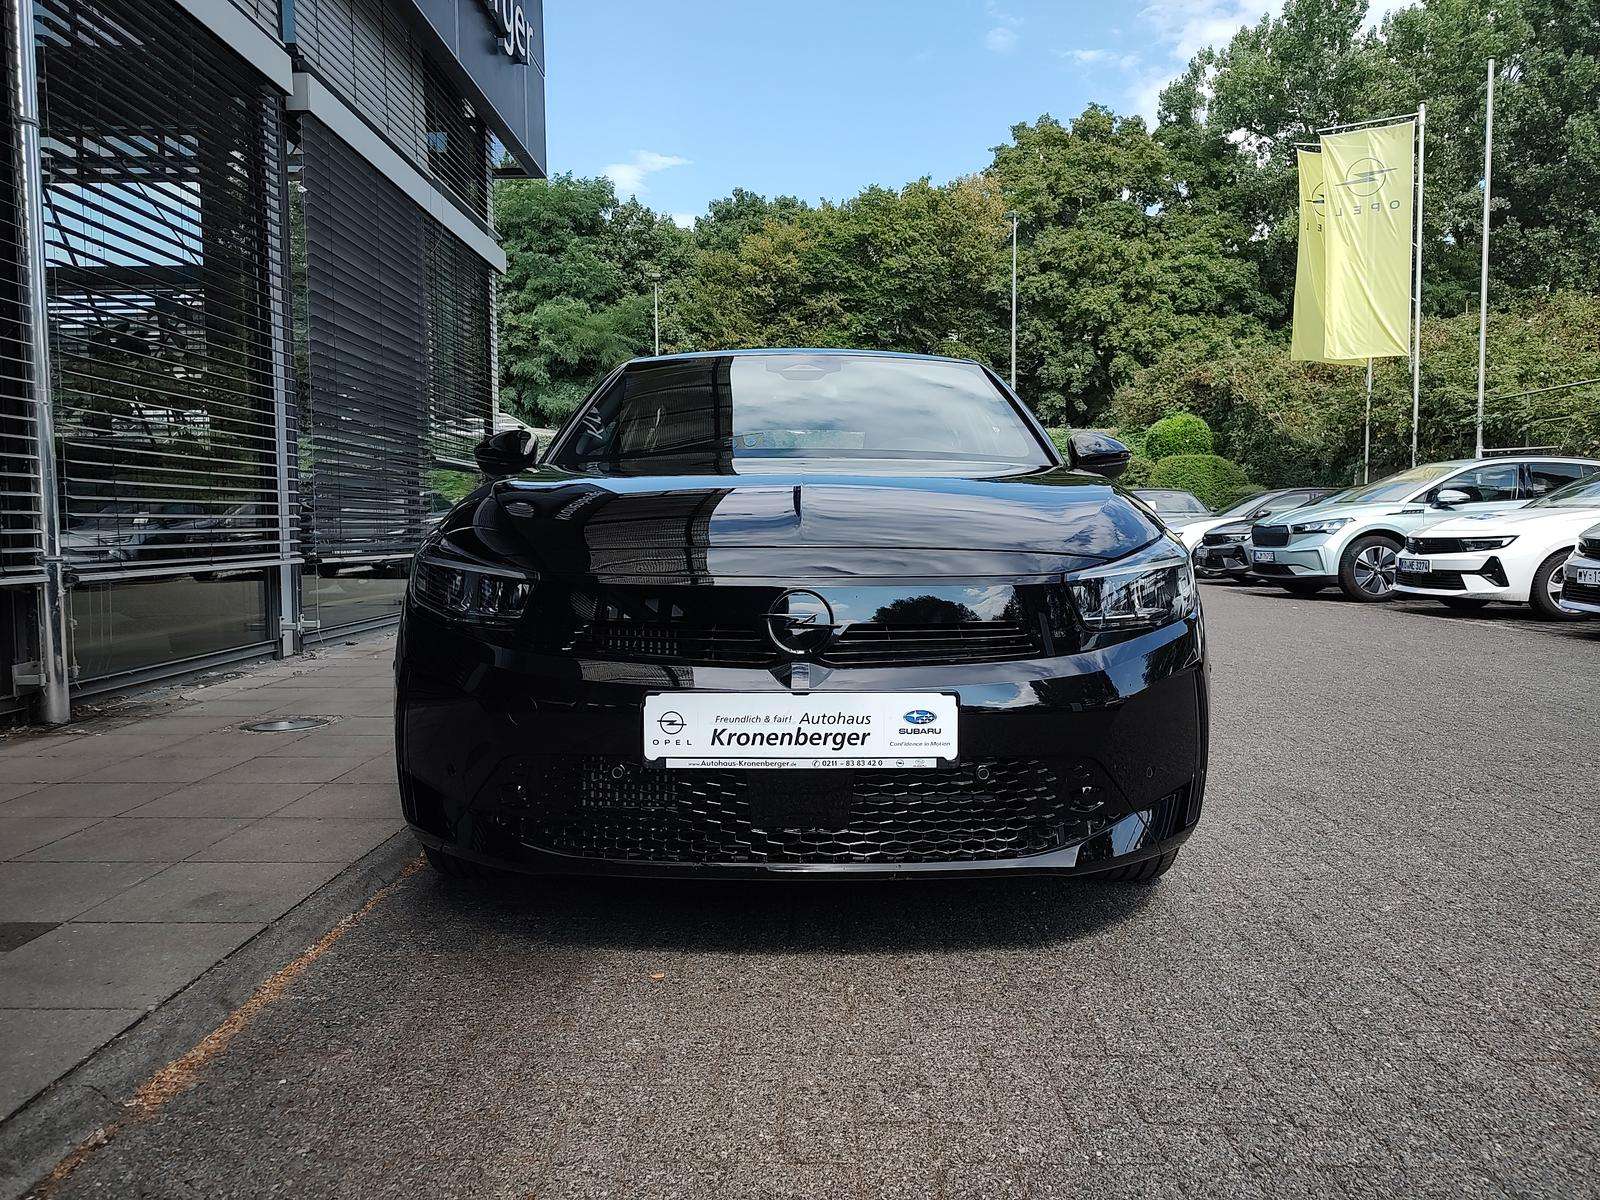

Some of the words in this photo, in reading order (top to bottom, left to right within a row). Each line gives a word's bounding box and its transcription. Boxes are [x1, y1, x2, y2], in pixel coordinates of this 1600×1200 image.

[715, 715, 761, 723] Freundlich
[764, 715, 770, 723] &
[773, 715, 792, 723] fair!
[799, 712, 871, 725] Autohaus
[711, 727, 870, 751] Kronenberger
